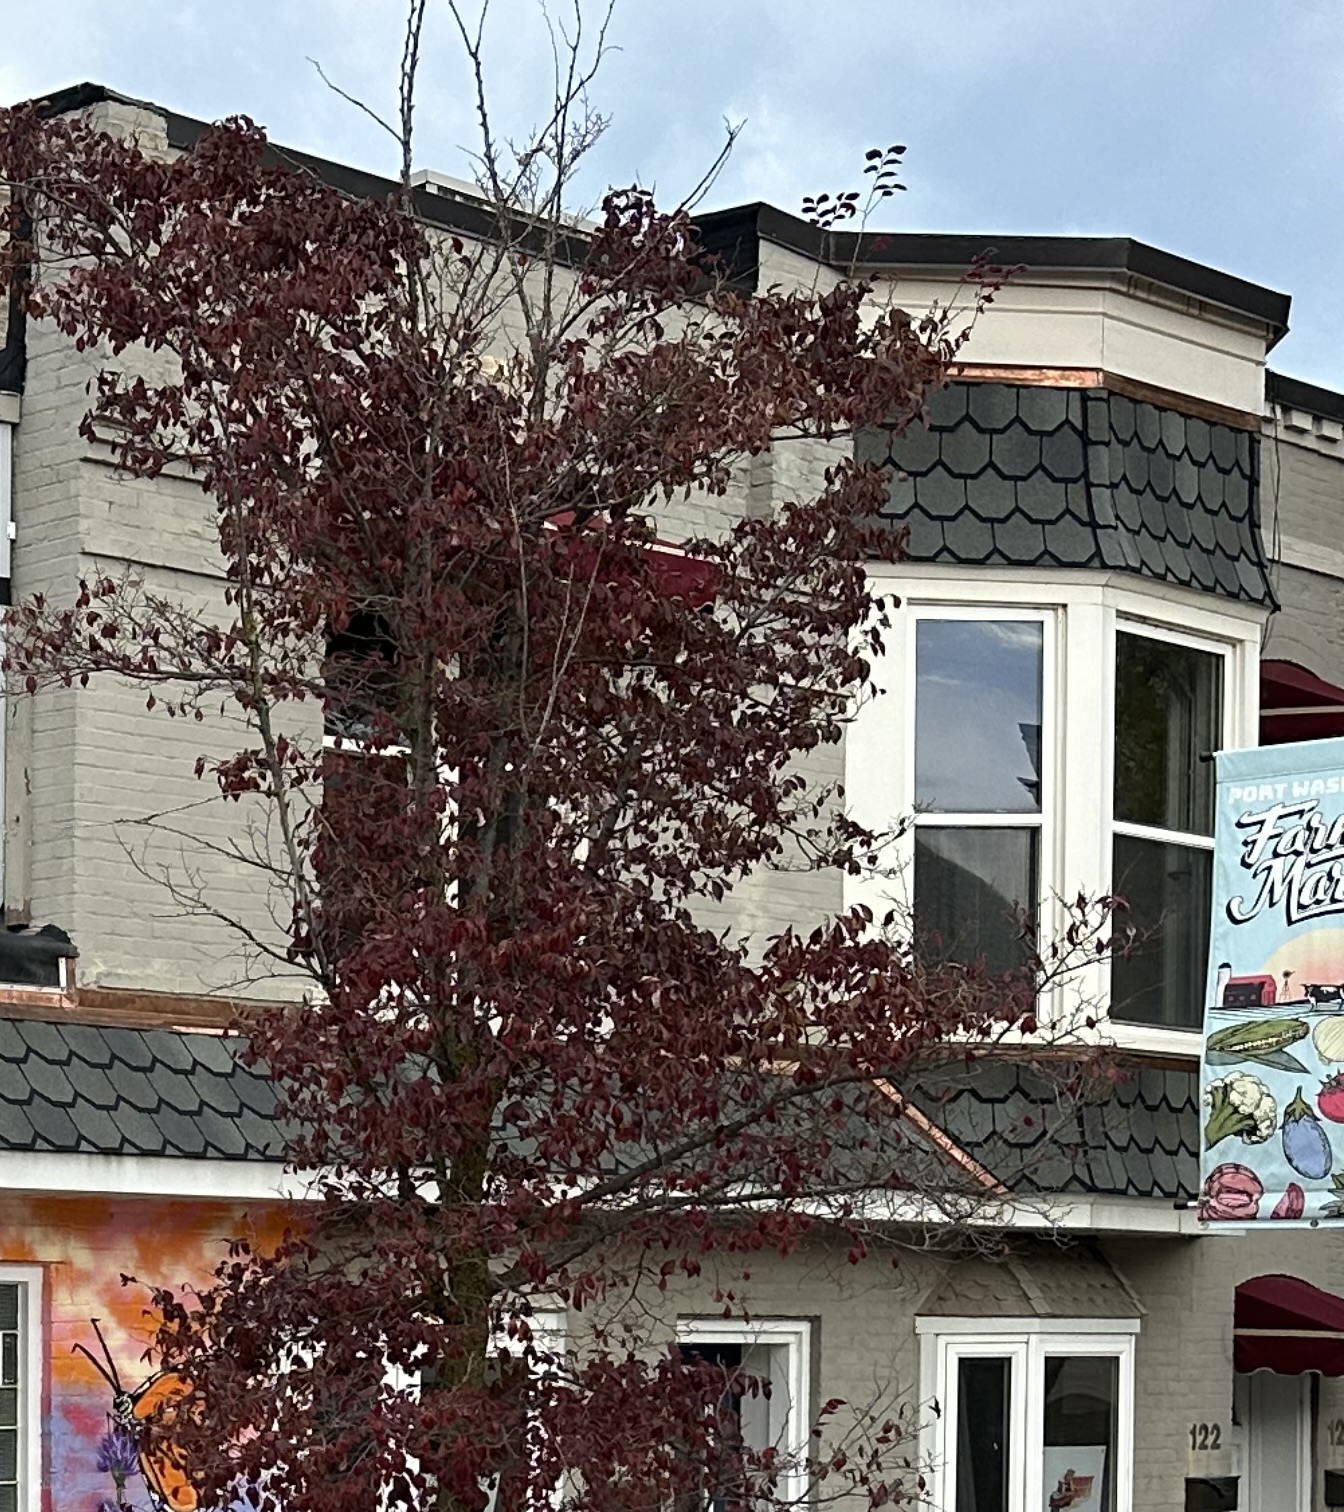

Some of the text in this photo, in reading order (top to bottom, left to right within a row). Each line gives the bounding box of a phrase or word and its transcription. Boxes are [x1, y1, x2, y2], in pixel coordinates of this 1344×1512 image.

[1228, 776, 1344, 804] PORT WAS
[1189, 1423, 1221, 1450] 122
